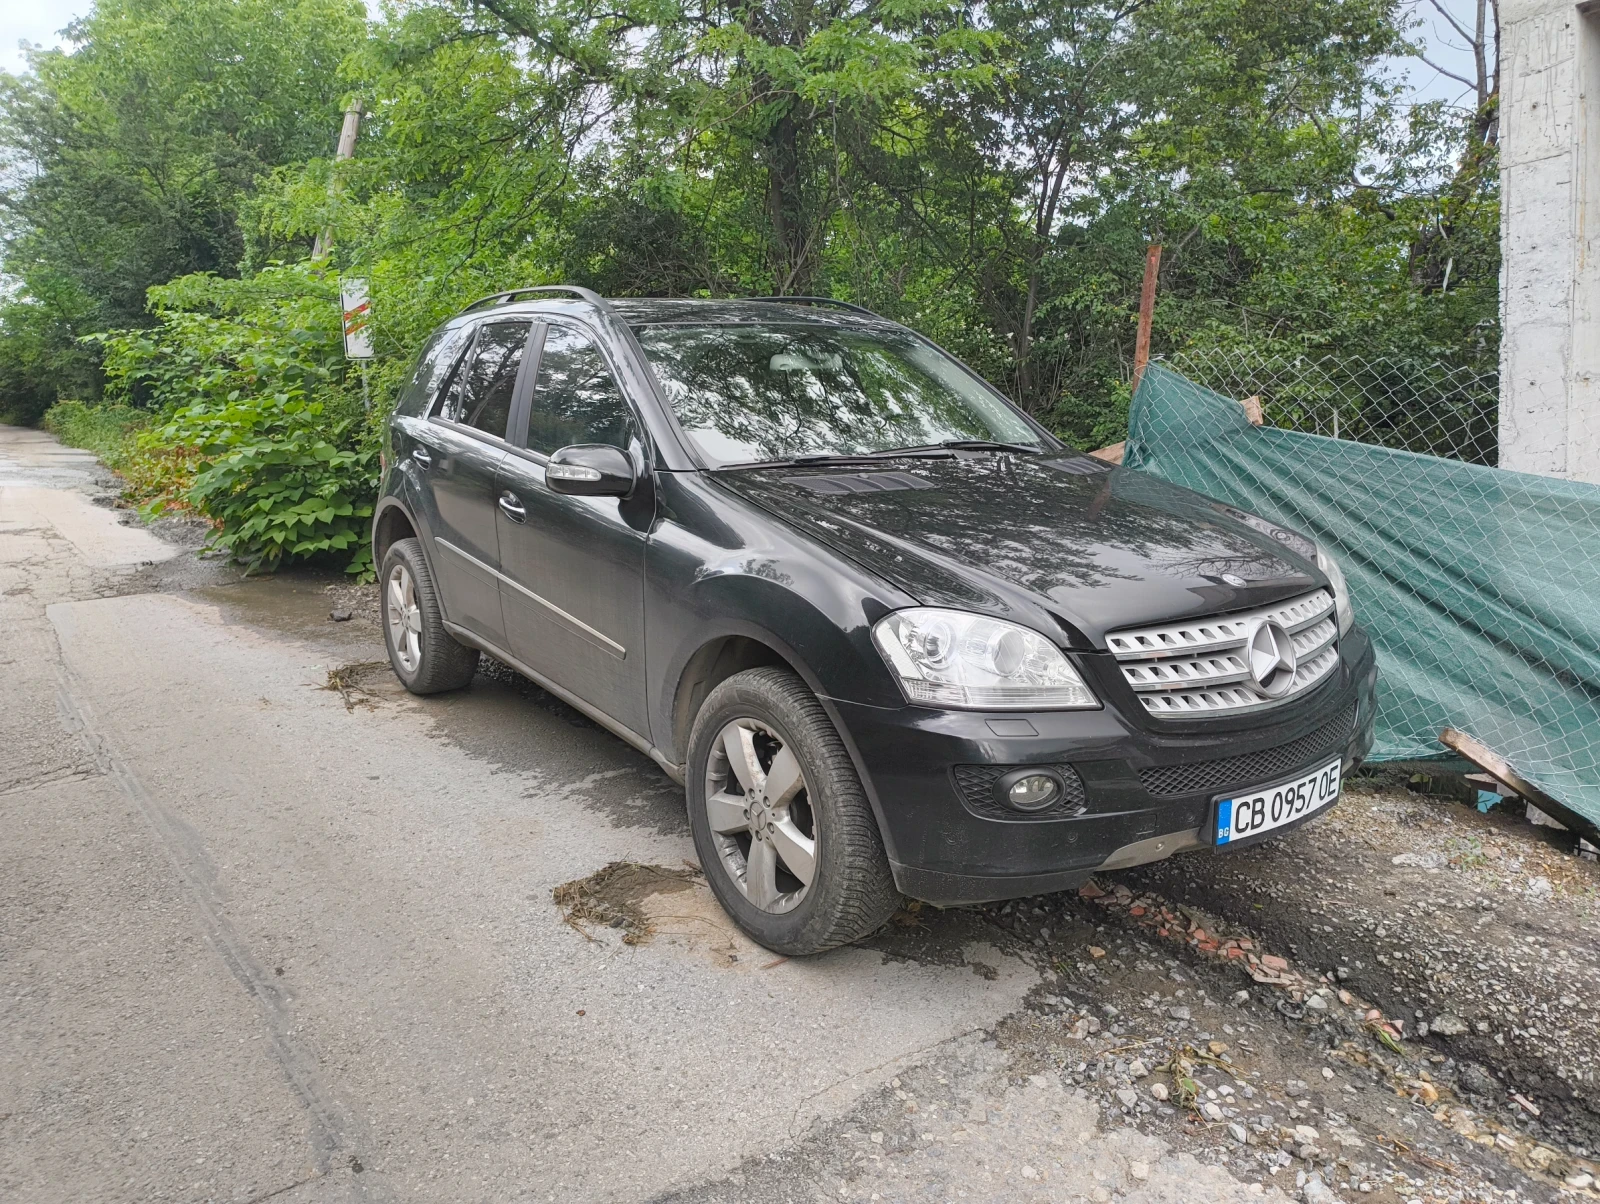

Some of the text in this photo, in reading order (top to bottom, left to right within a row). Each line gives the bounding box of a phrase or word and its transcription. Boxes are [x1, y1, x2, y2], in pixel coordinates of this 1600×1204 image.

[1234, 764, 1339, 834] CB 0957 OE
[1218, 827, 1230, 839] BG
